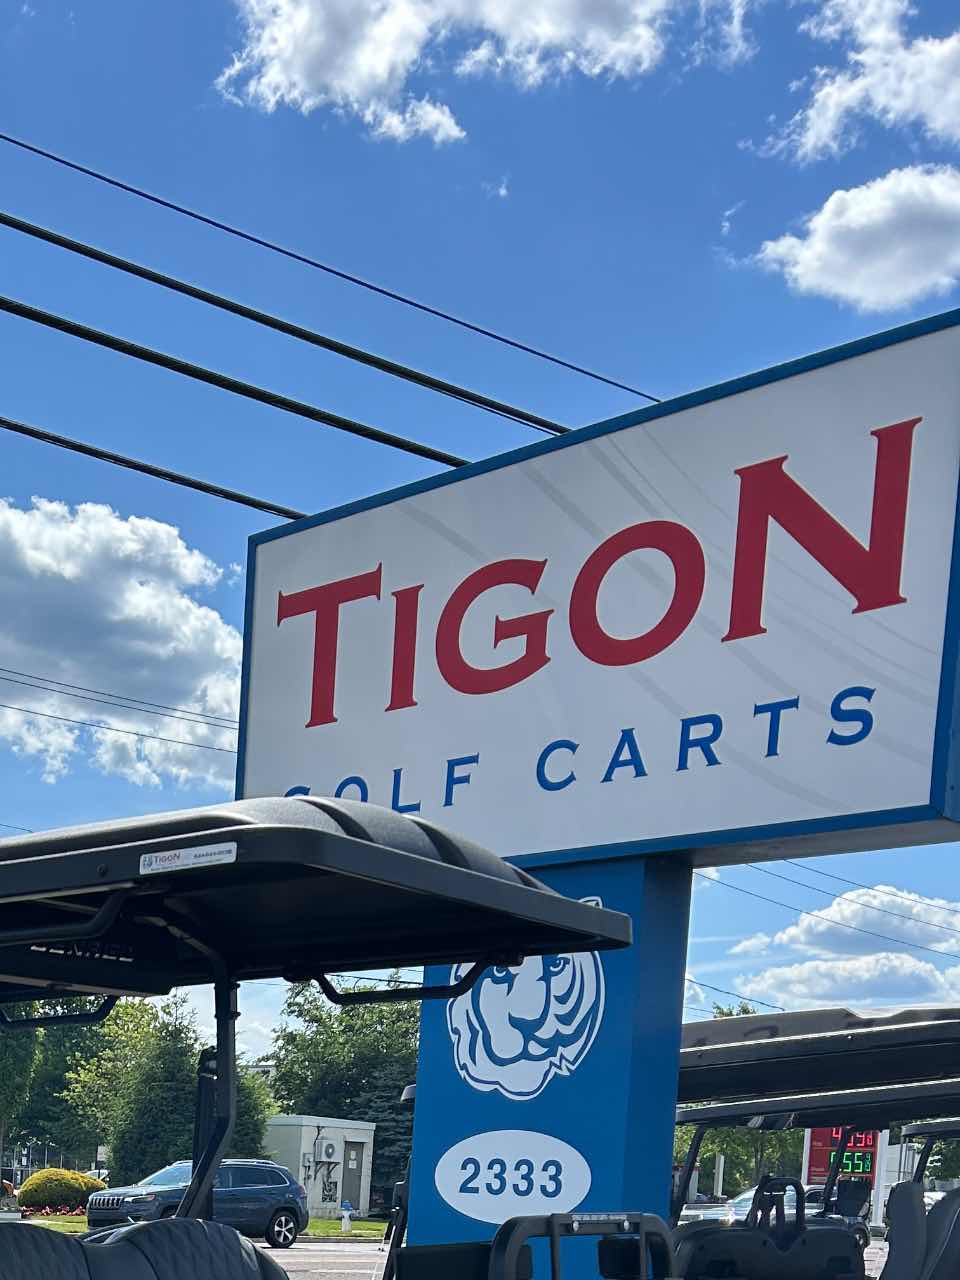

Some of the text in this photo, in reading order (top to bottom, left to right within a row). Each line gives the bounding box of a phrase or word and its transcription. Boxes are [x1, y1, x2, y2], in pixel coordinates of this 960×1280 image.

[277, 416, 923, 728] TIGON
[283, 685, 876, 814] OLF CARTS
[458, 1157, 563, 1199] 2333
